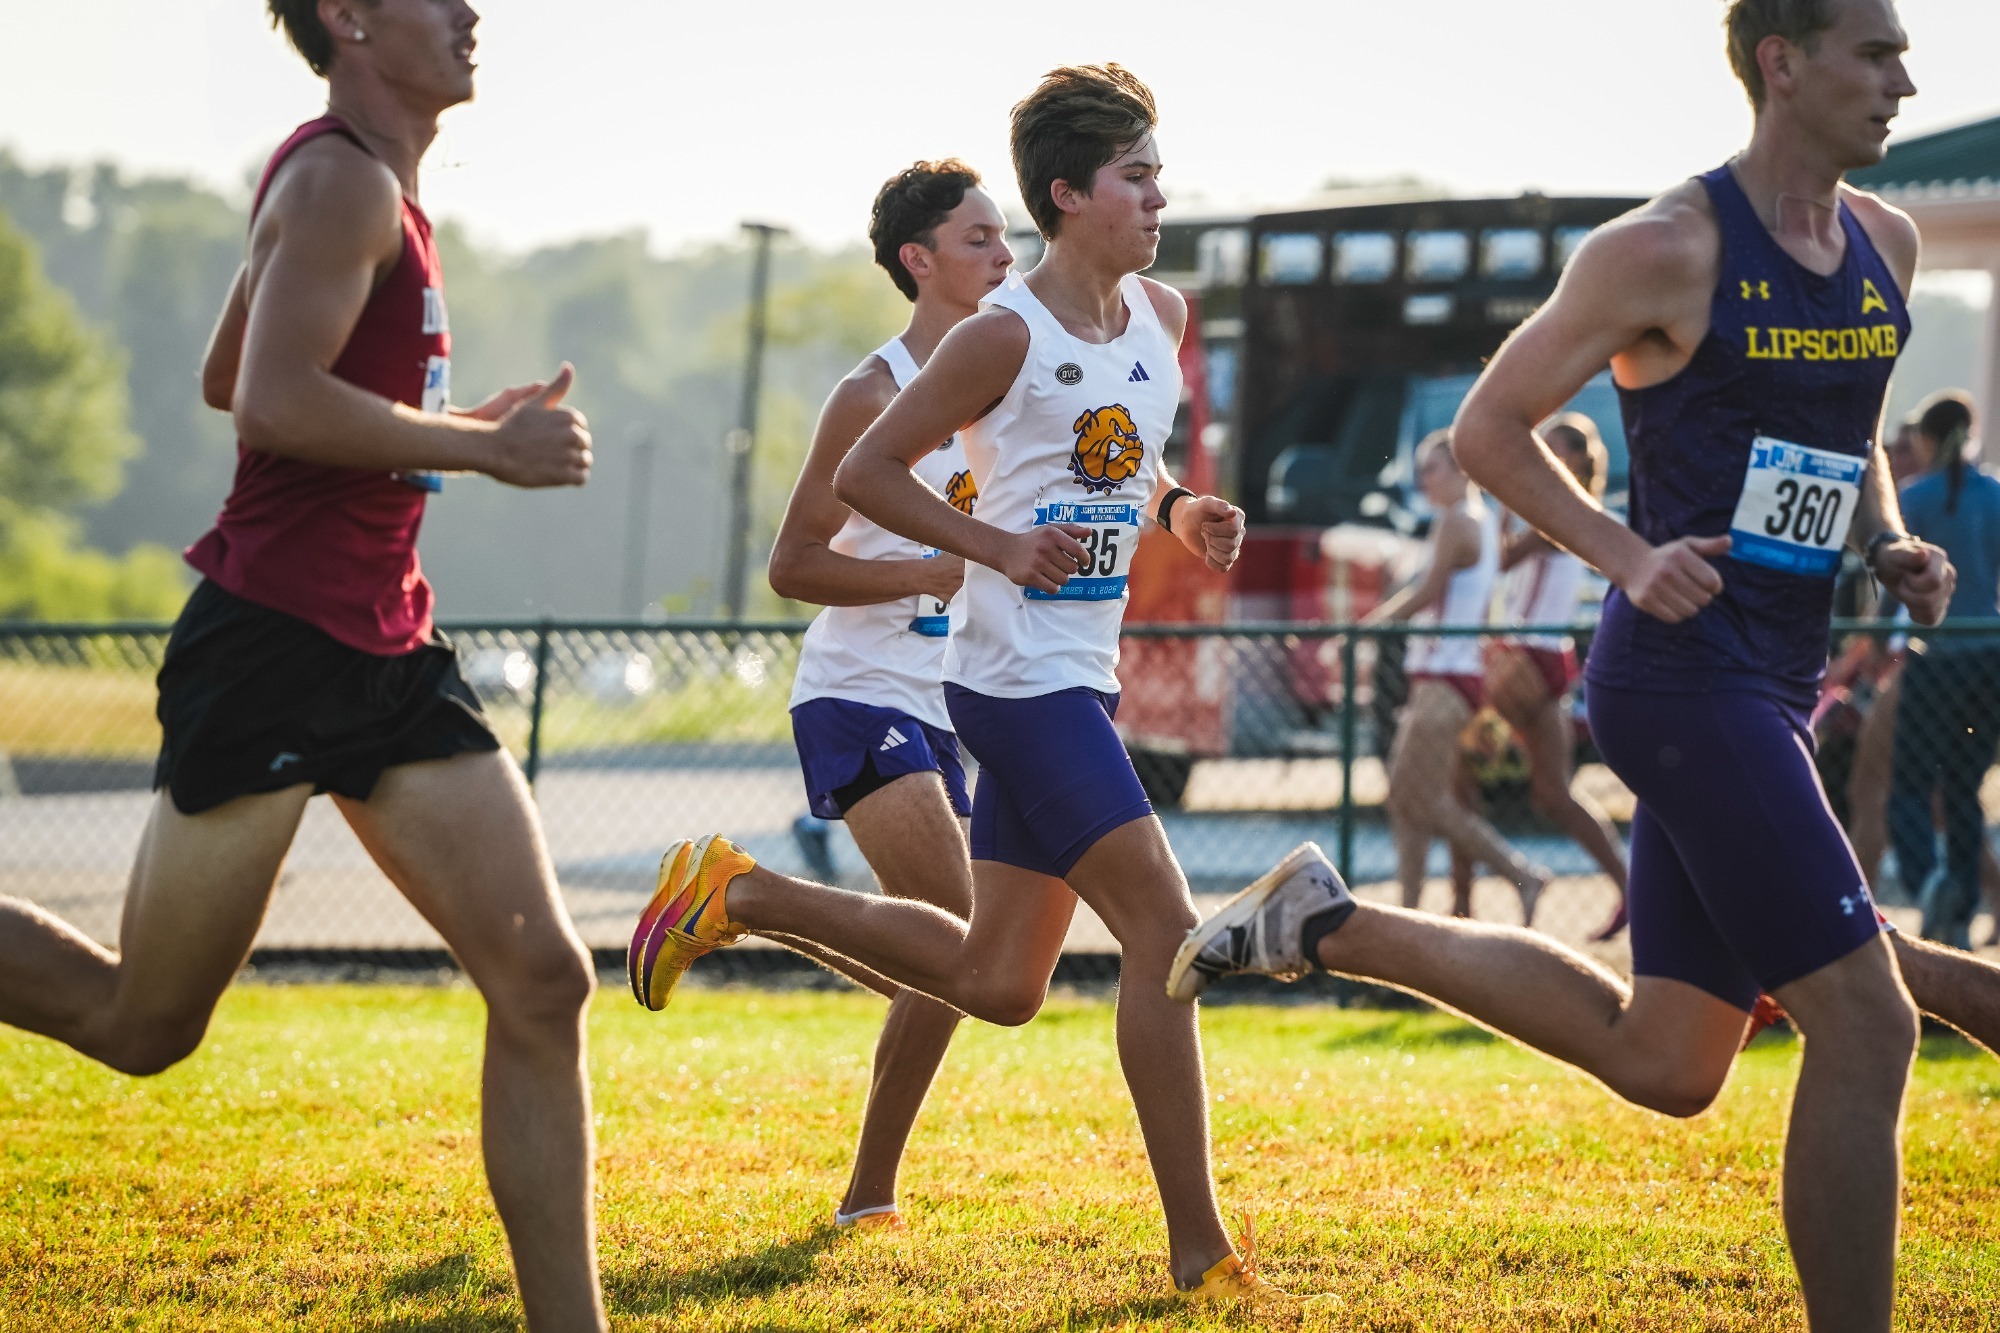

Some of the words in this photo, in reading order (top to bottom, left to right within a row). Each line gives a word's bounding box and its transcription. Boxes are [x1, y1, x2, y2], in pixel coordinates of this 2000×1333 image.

[1745, 324, 1898, 361] LIPSCOMB
[1053, 505, 1076, 521] JM
[1764, 478, 1842, 546] 360
[1077, 528, 1120, 577] 35
